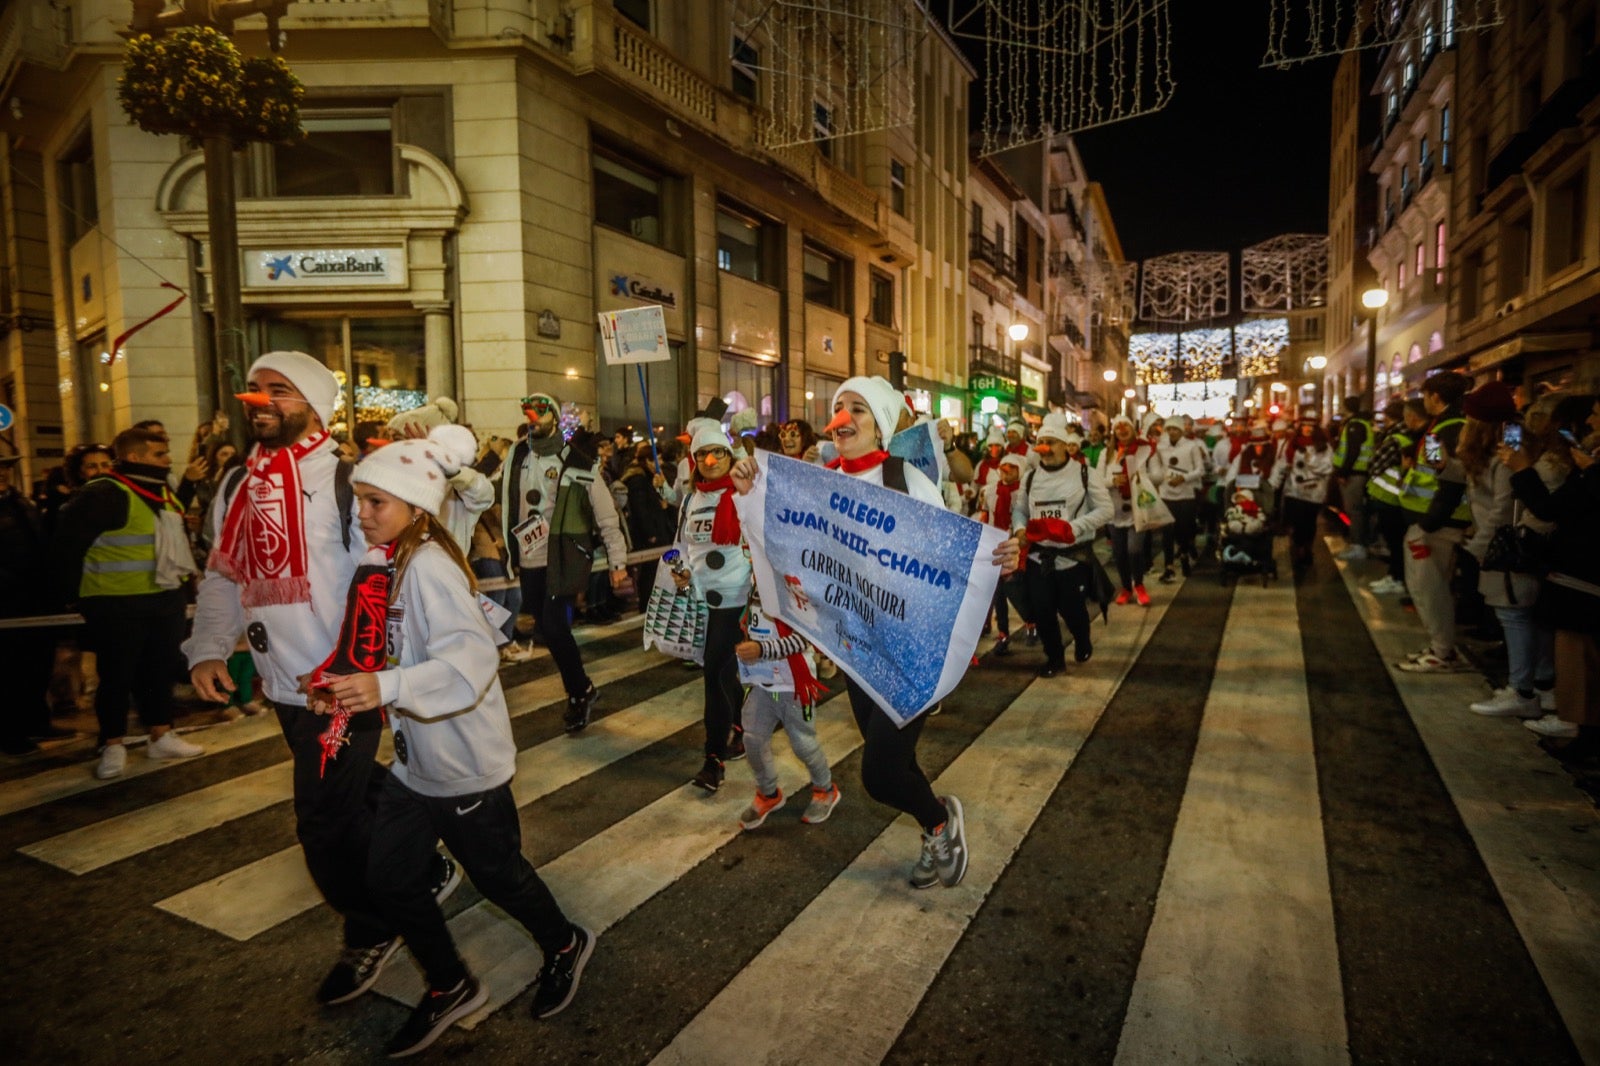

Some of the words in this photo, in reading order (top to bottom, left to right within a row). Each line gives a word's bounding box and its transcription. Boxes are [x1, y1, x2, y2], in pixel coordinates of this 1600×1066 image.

[300, 256, 385, 274] CaixaBank
[829, 491, 896, 534] COLEGIO
[524, 525, 543, 545] 917
[776, 508, 829, 535] JUAN
[831, 523, 952, 590] XXIII-CHANA
[801, 548, 852, 588] CARRERA
[855, 571, 905, 621] NOCTURA
[824, 583, 874, 628] GRANADA
